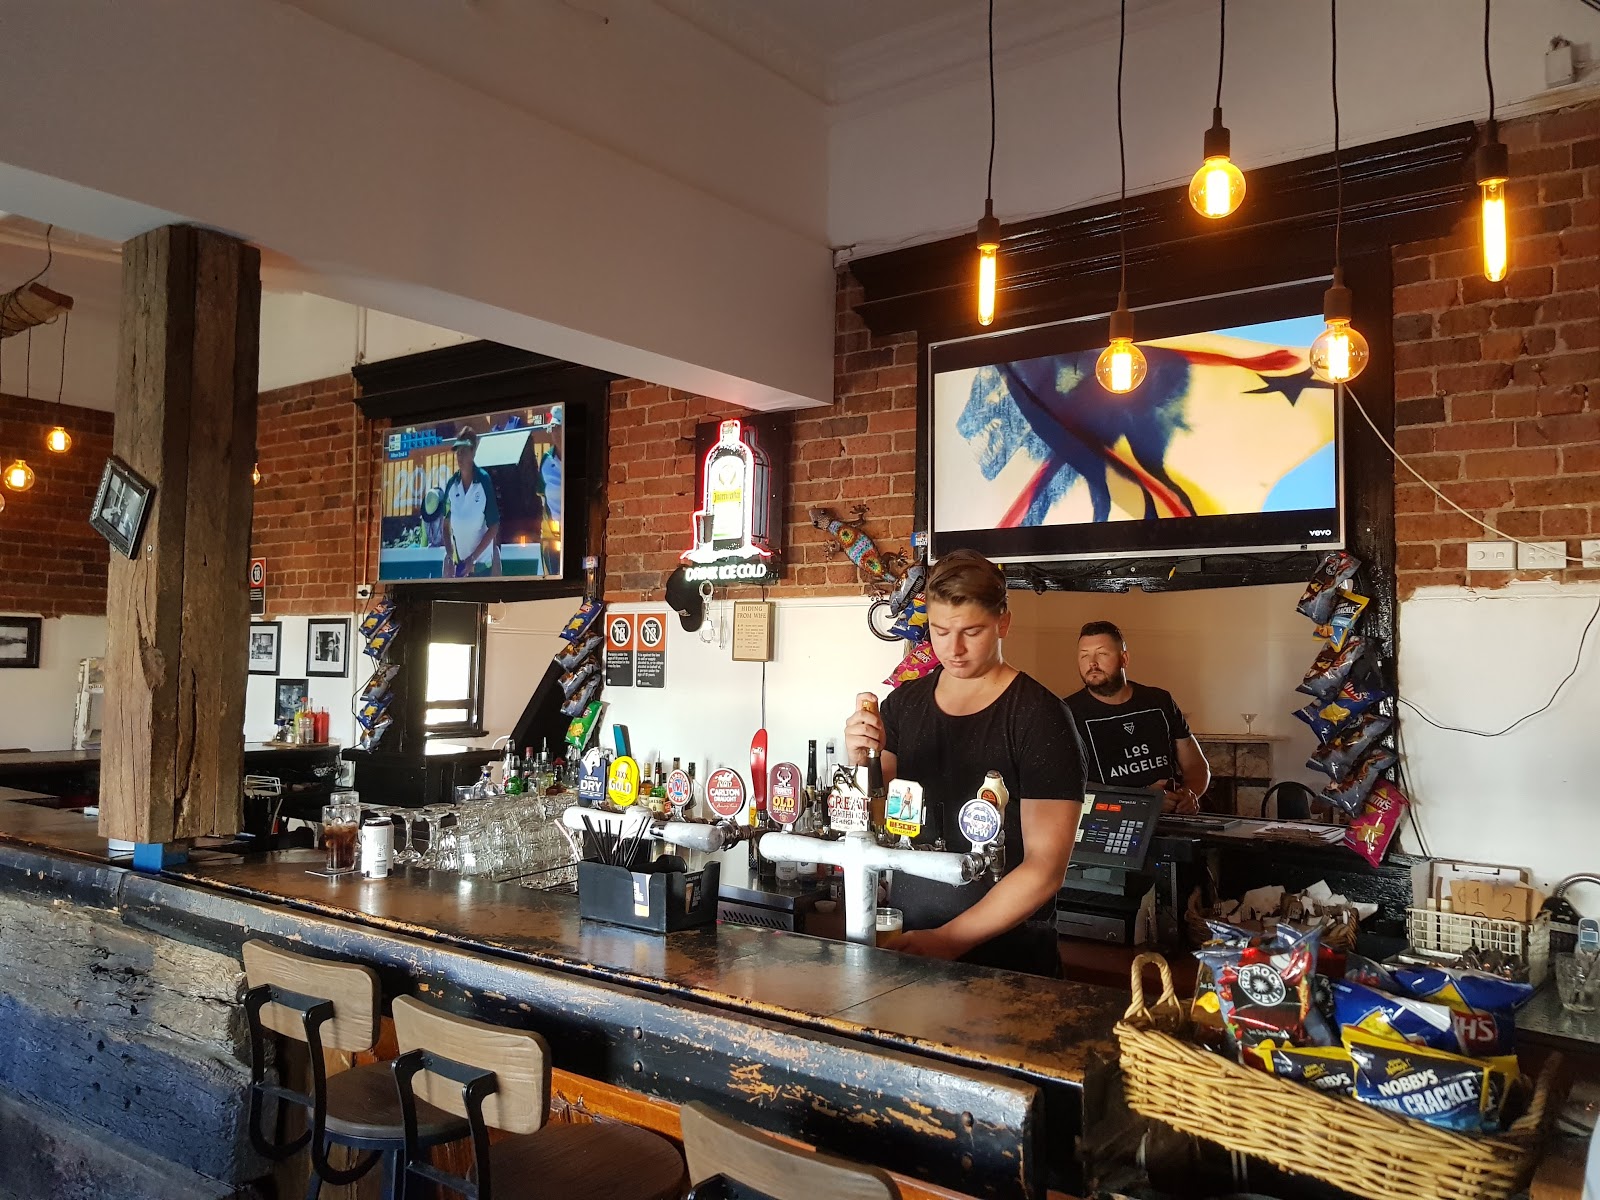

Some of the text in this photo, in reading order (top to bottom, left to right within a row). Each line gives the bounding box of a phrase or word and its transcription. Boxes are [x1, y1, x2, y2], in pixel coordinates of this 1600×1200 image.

[719, 564, 737, 580] ICE
[736, 563, 767, 578] COLD
[645, 627, 657, 641] 18
[1124, 743, 1150, 759] LOS
[1110, 755, 1168, 778] ANGELES
[580, 779, 603, 792] DRY
[609, 779, 632, 794] GOLD
[709, 788, 741, 798] CARLTON
[772, 796, 795, 808] OLD
[827, 793, 871, 812] GREAT
[966, 825, 989, 838] NEW
[1252, 992, 1281, 1003] DELI
[1378, 1068, 1439, 1097] NOBBYS
[1402, 1079, 1479, 1116] CRACKLE
